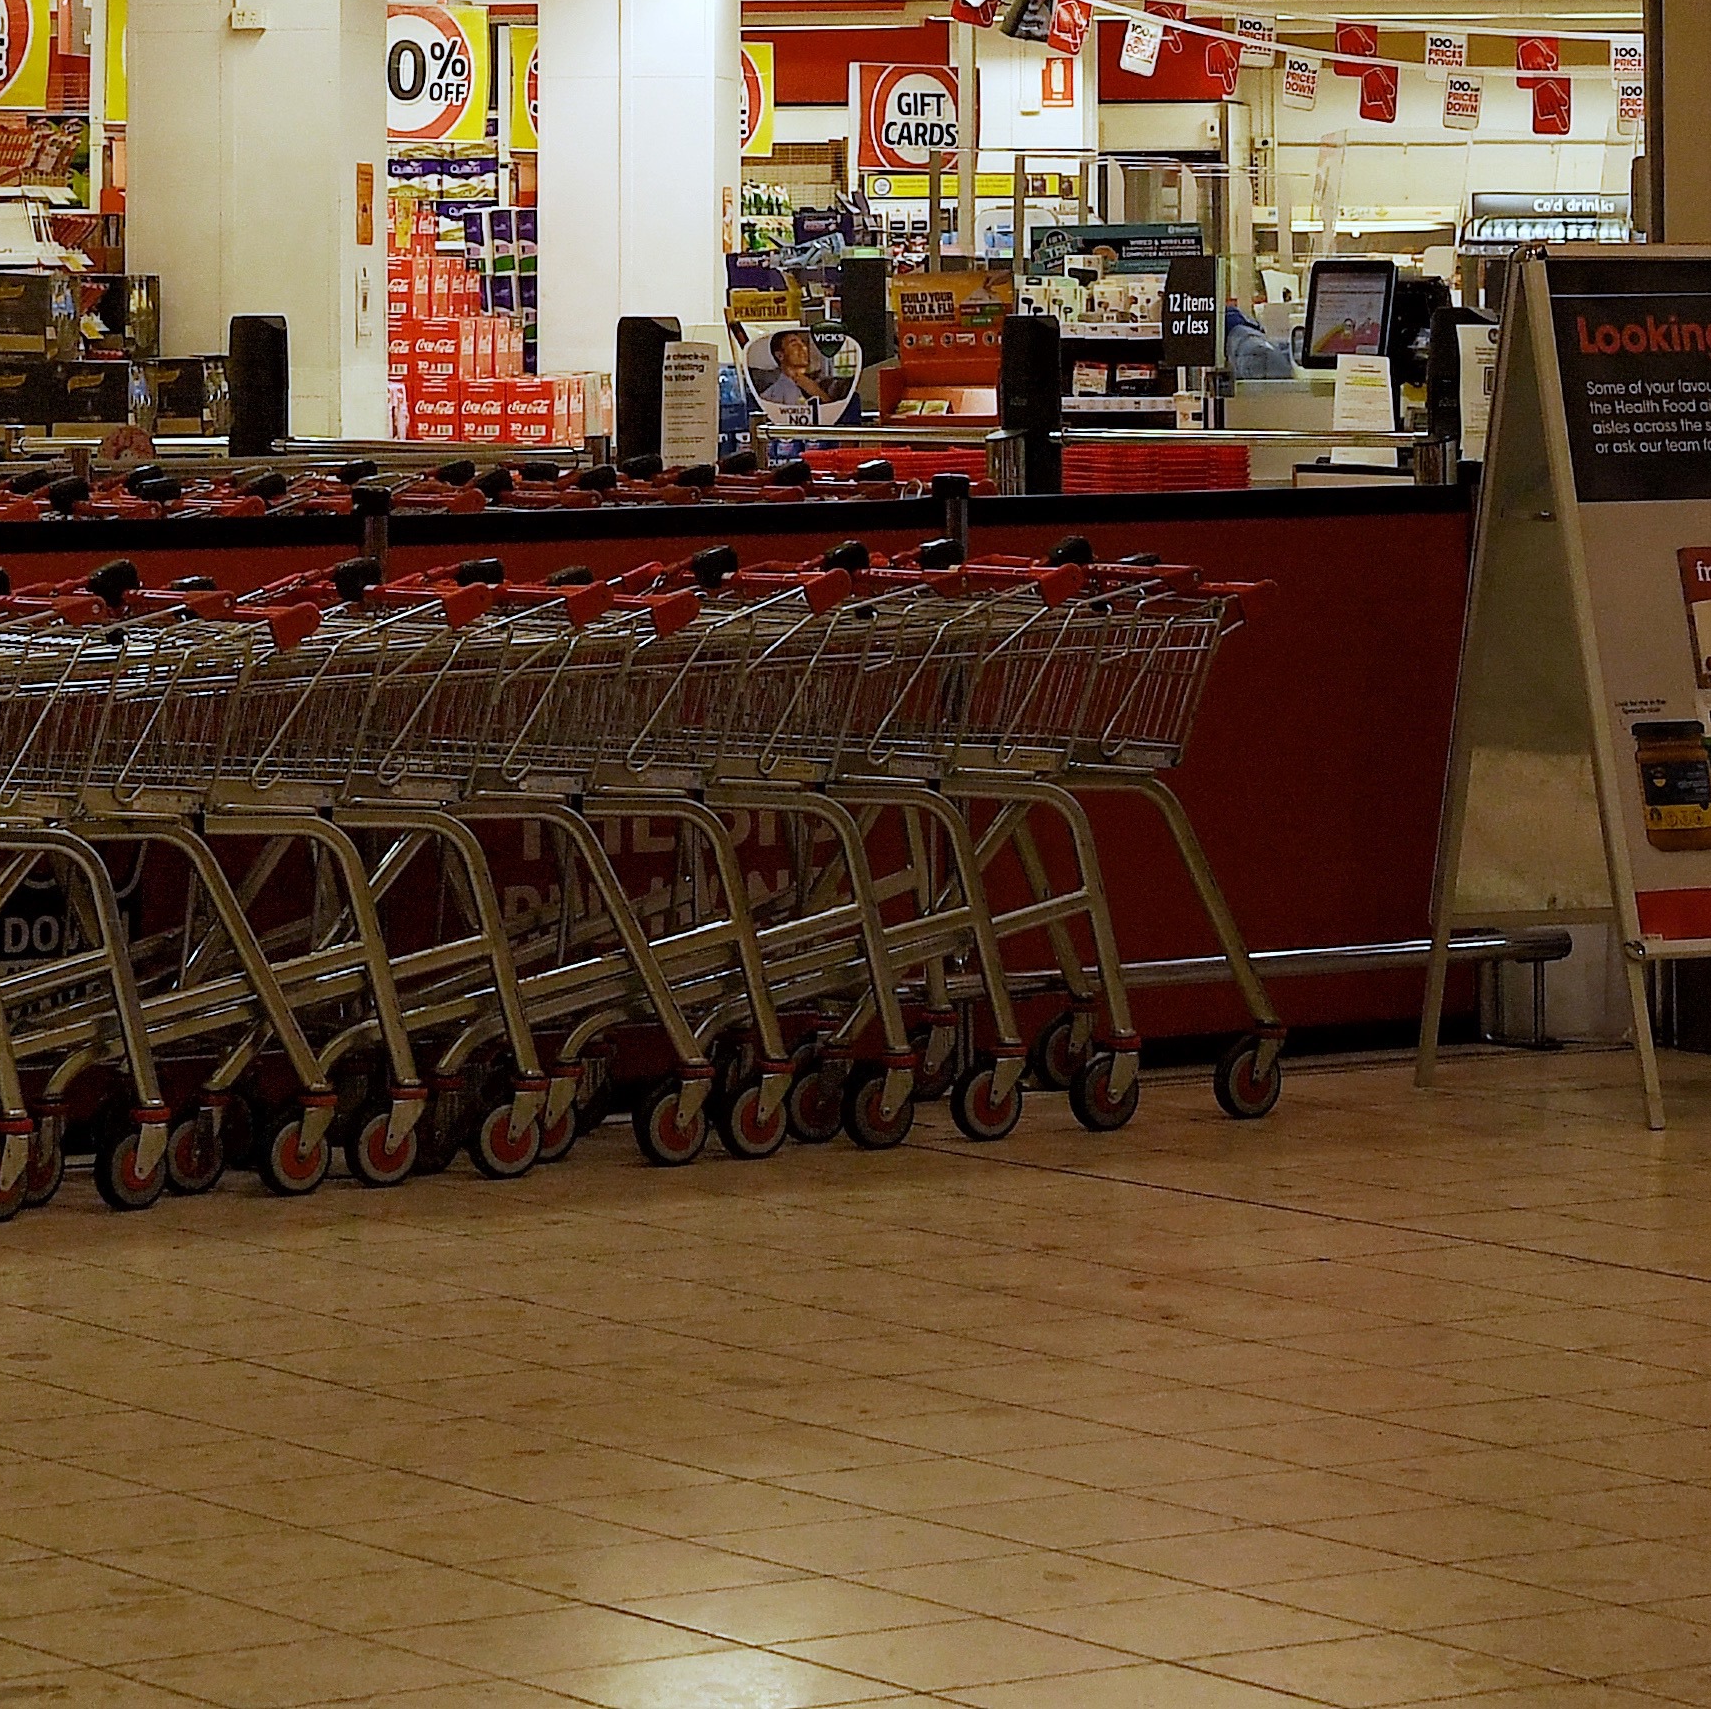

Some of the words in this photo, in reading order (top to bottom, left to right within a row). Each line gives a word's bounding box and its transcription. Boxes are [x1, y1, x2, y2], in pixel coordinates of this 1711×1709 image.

[429, 82, 467, 103] OFF
[896, 92, 946, 117] GIFT
[884, 120, 957, 147] CARDS
[900, 291, 926, 304] BUILD
[928, 291, 954, 304] YOUR
[1169, 293, 1180, 312] 12
[1182, 292, 1215, 312] items
[901, 304, 927, 315] COLD
[937, 303, 955, 314] FLU
[1172, 319, 1186, 335] or
[1187, 316, 1209, 334] less
[813, 334, 845, 342] VICKS
[1586, 381, 1626, 395] Some
[1629, 380, 1642, 393] of
[1644, 382, 1675, 397] your
[1589, 400, 1611, 415] the
[1615, 398, 1660, 414] Health
[1663, 398, 1697, 413] Food
[1592, 420, 1630, 435] aisles
[1633, 420, 1677, 434] across
[1680, 418, 1702, 433] the
[1595, 441, 1610, 455] or
[1612, 440, 1636, 454] ask
[1639, 441, 1663, 453] our
[1665, 439, 1701, 452] team
